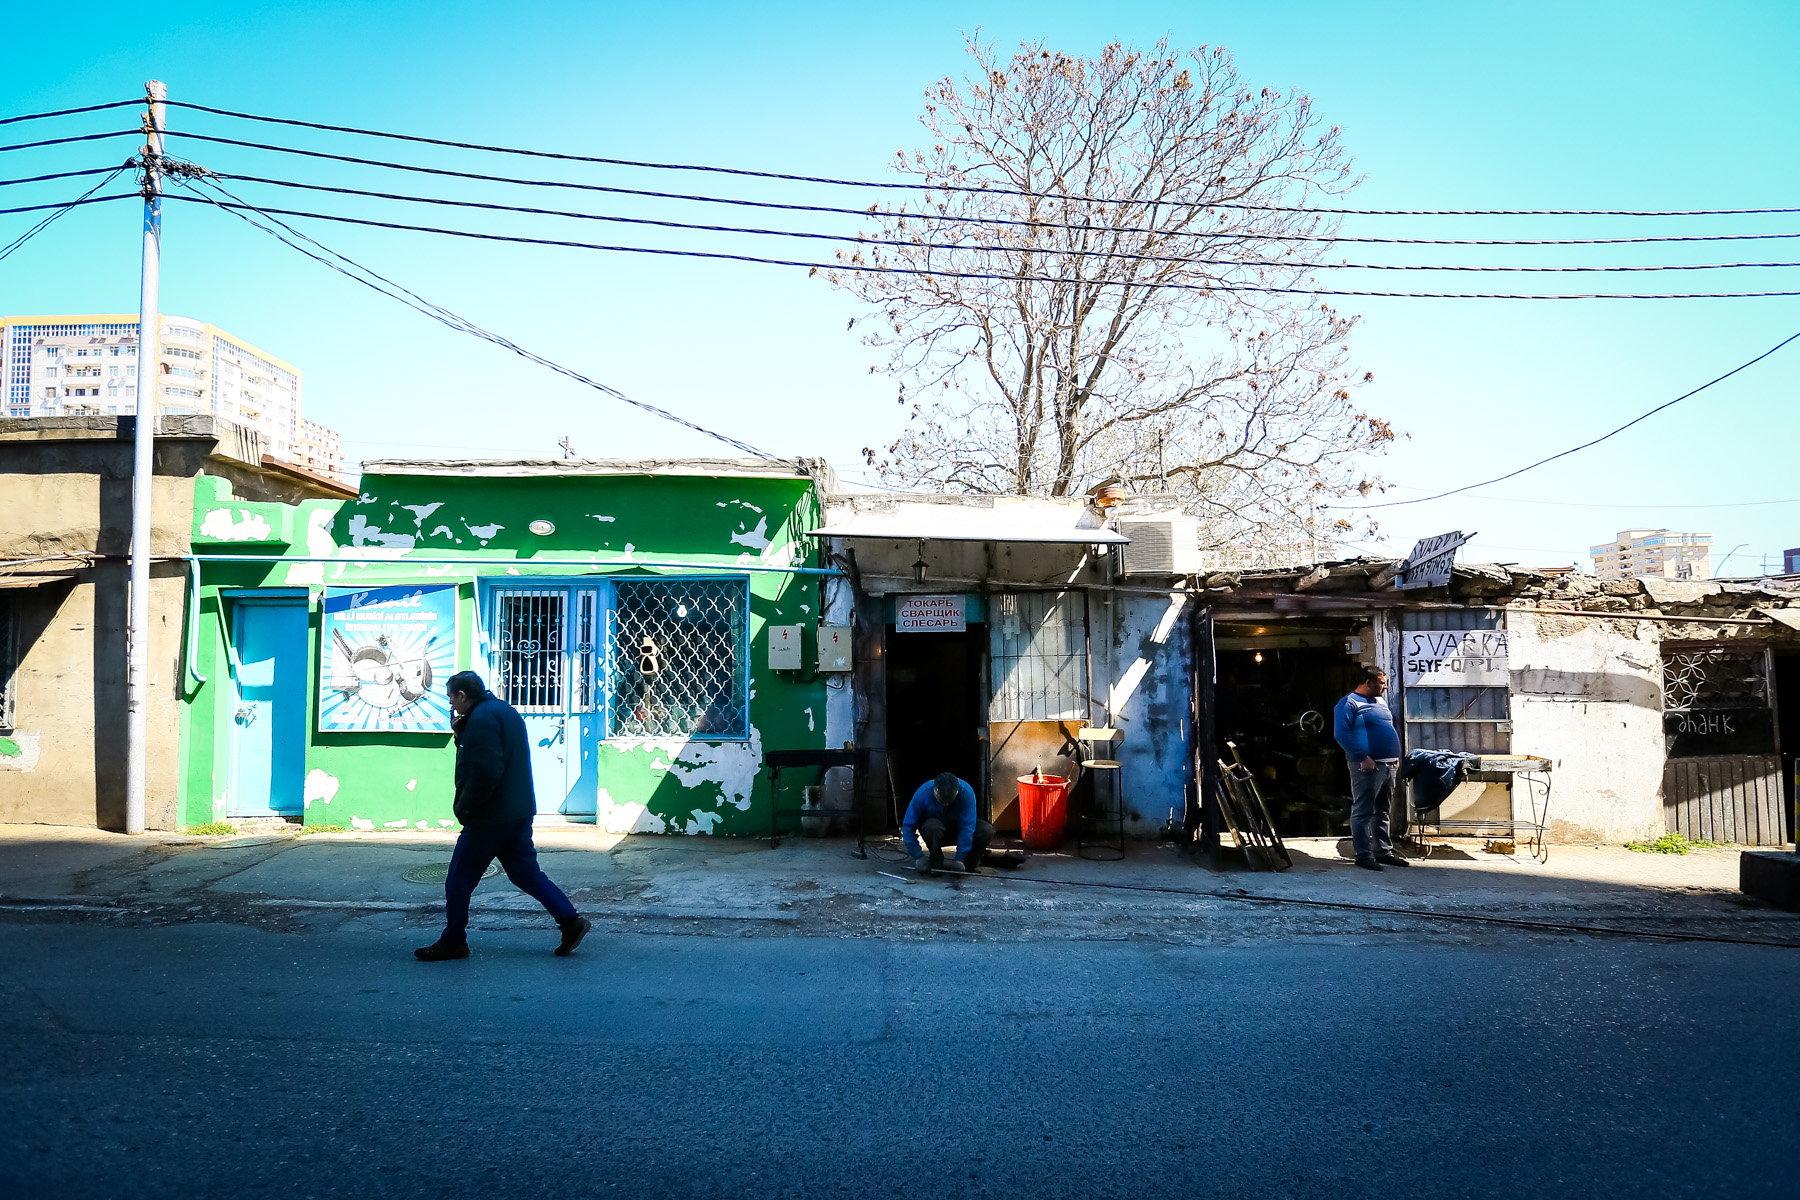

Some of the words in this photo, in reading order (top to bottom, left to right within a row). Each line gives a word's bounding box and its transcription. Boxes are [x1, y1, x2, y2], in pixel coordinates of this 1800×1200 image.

[901, 609, 960, 618] СВАРЩИК
[902, 619, 958, 627] СЛЕСАРЬ
[1409, 632, 1508, 657] SVARKA
